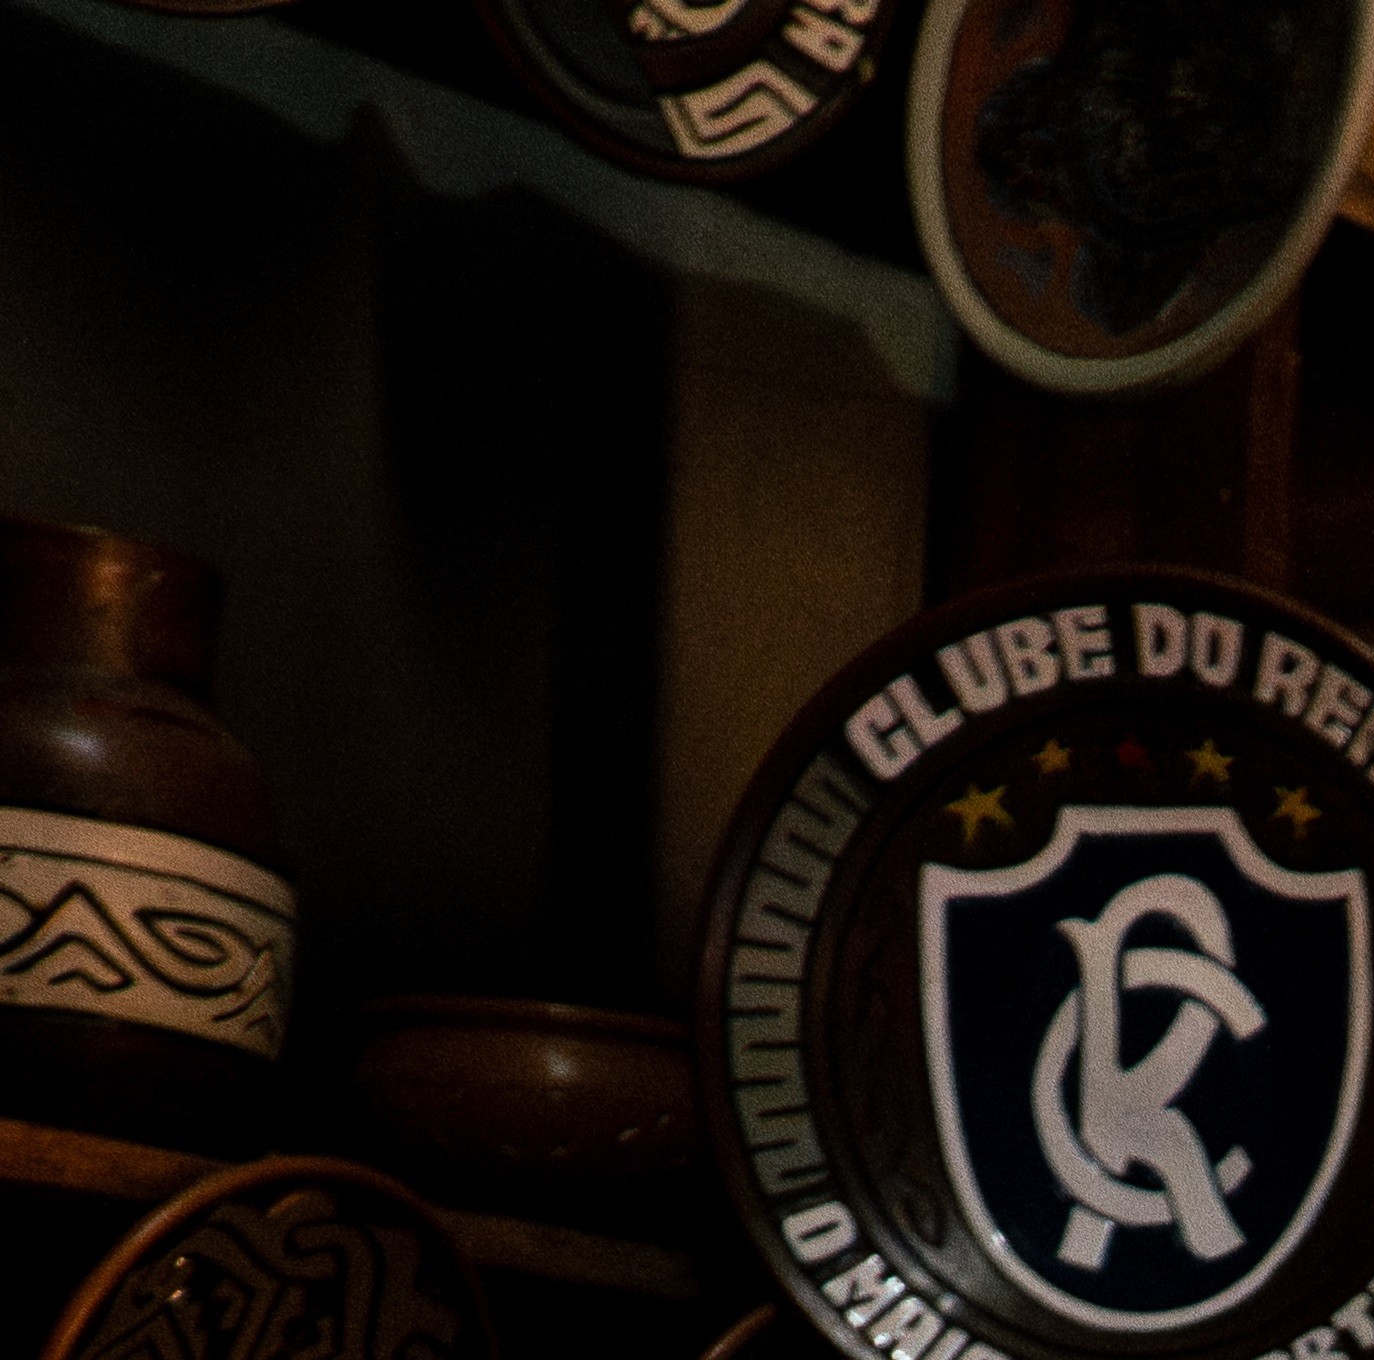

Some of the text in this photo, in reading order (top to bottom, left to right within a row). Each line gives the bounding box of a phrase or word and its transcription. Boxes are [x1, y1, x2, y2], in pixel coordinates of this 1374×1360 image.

[843, 604, 1119, 781] CLUBE
[1128, 601, 1248, 687] DO
[781, 1200, 859, 1266] O
